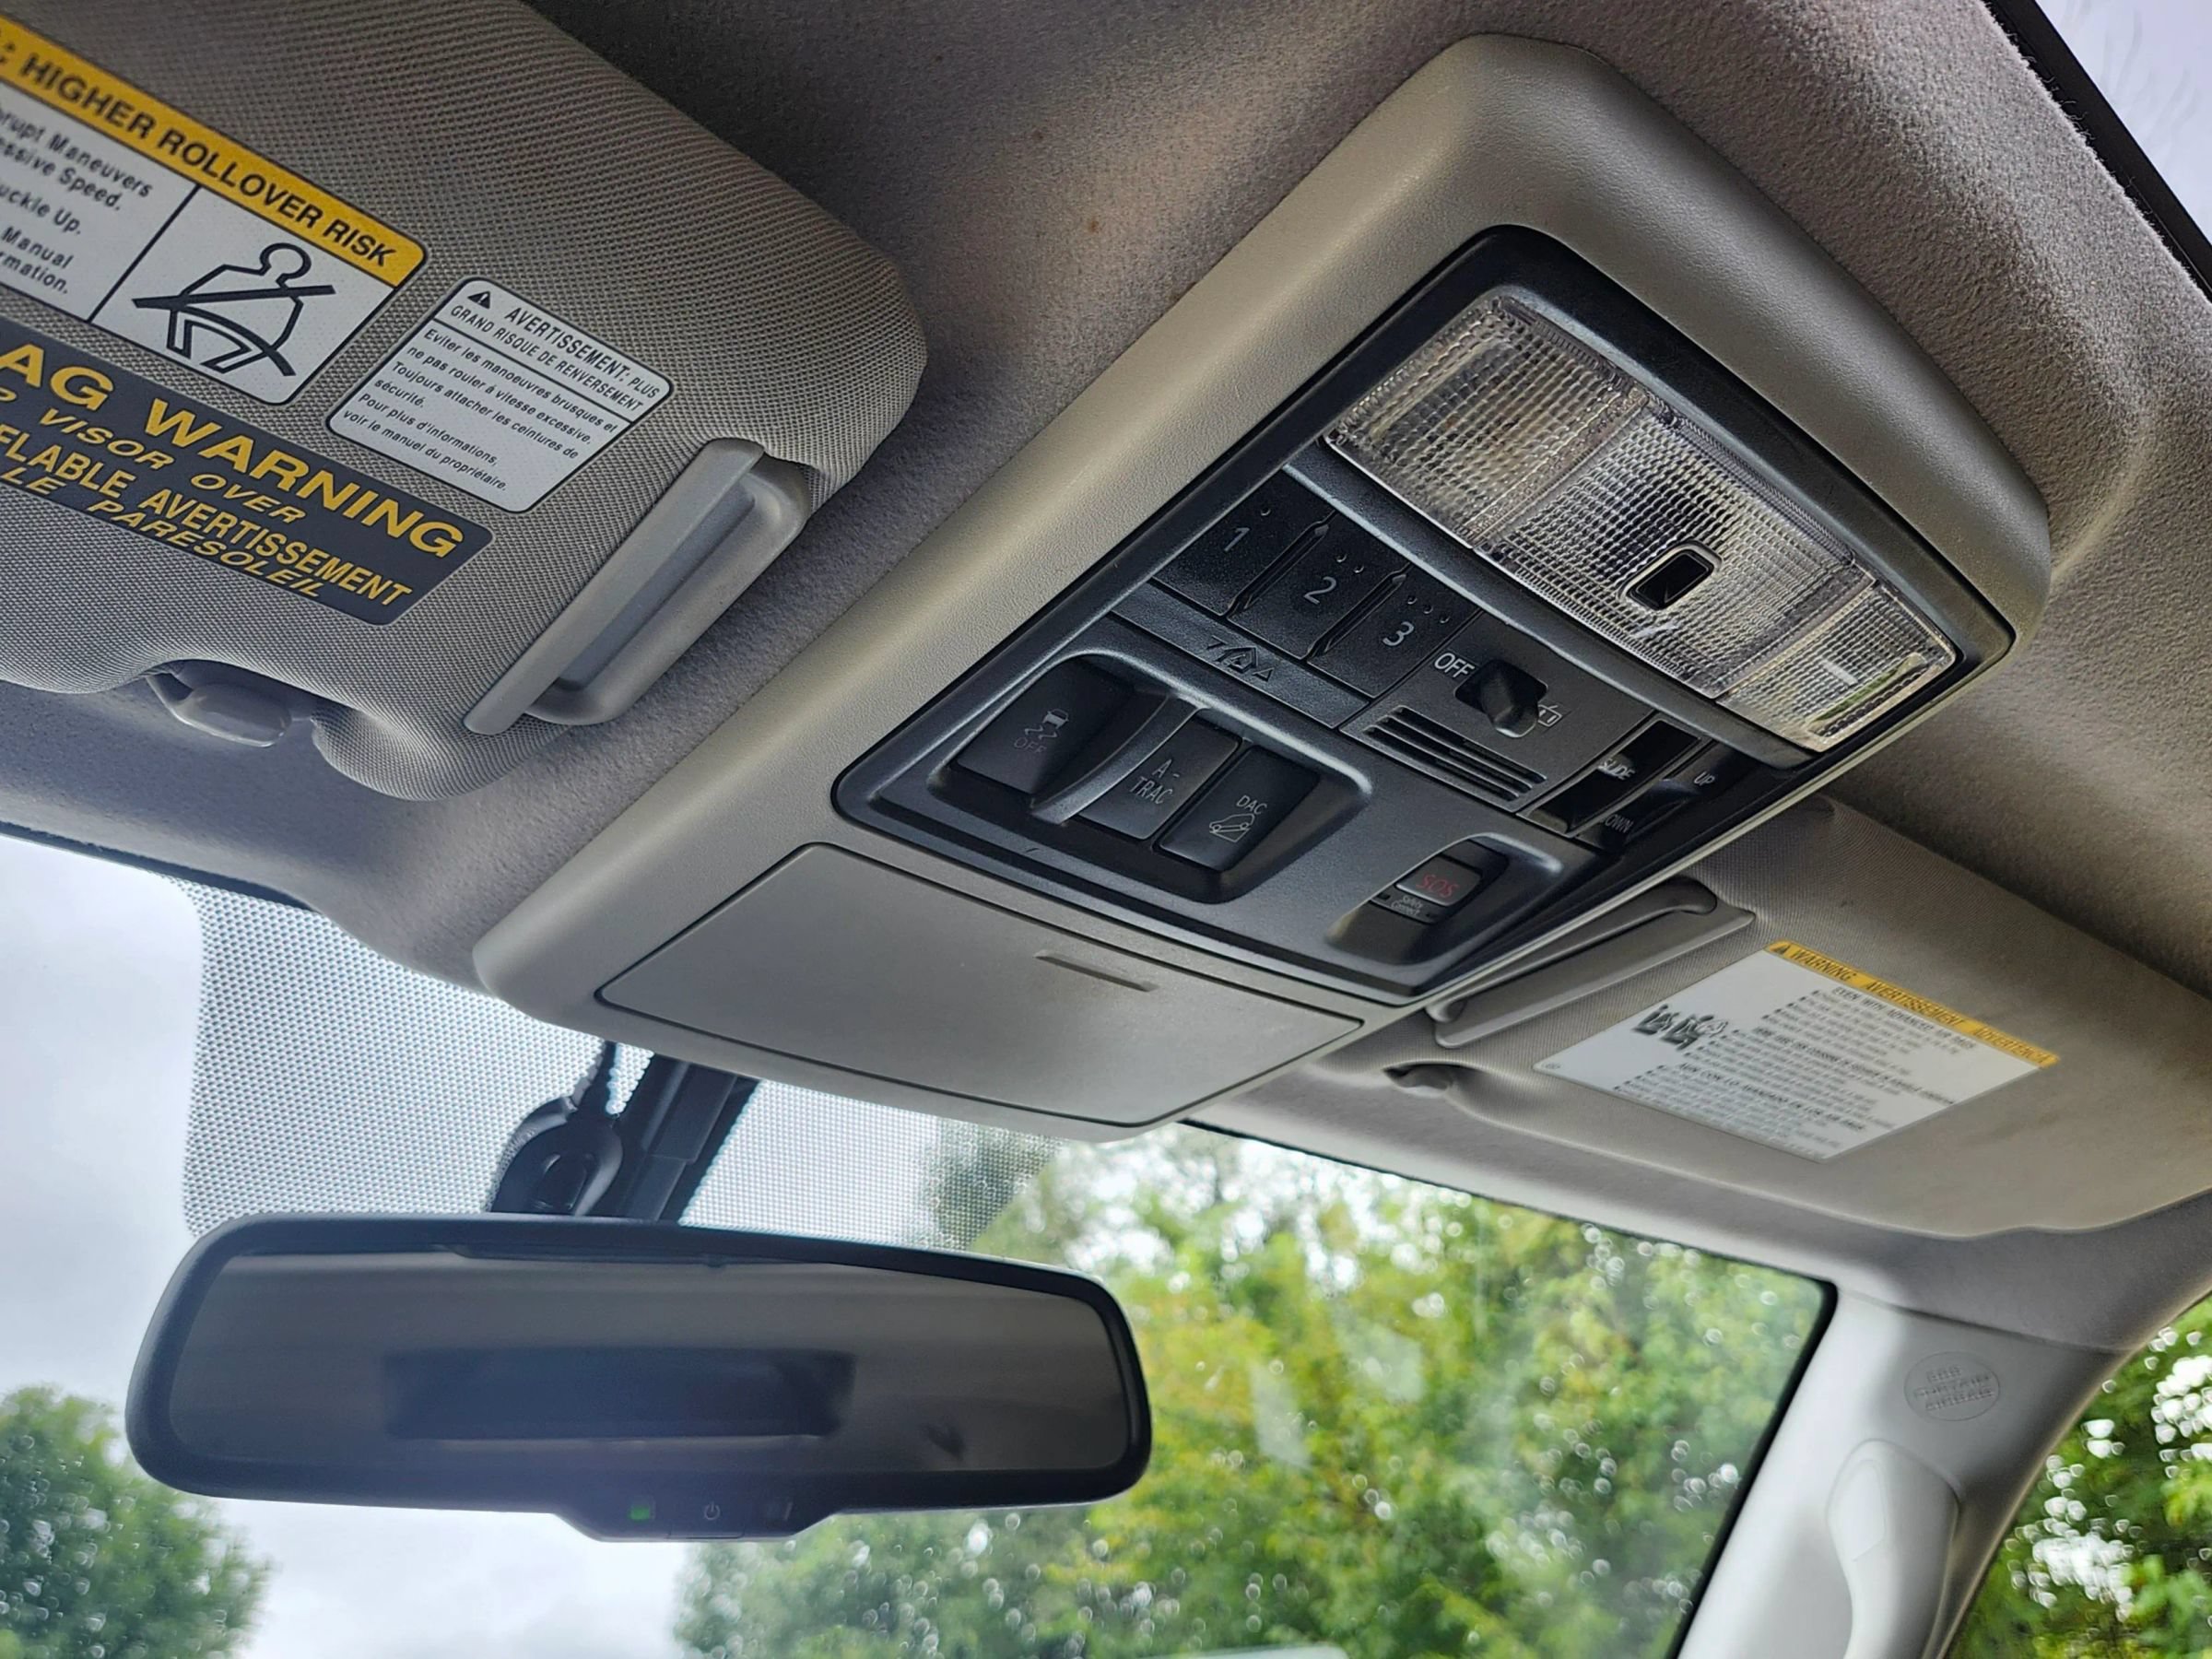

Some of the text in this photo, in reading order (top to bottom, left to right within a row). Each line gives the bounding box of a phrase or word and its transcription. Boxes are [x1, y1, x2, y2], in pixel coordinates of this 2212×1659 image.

[19, 53, 395, 267] HIGHER ROLLOVER RISK
[48, 133, 153, 197] Maneuvers
[59, 167, 123, 211] Speed.
[53, 207, 81, 234] Up.
[1, 226, 74, 270] Manual
[451, 305, 643, 411] GRAND RISQUE DE RENVERSEMENT
[504, 308, 660, 398] AVERTISSEMENT: PLUS
[374, 380, 425, 407] sécurité.
[407, 347, 424, 359] ne
[422, 356, 448, 371] pas
[449, 368, 486, 388] rouler
[496, 391, 535, 414] vitesse
[536, 412, 590, 444] excessive.
[424, 329, 618, 432] Eviter les manoeuvres brusques et
[359, 394, 497, 465] Pour plus d'informations,
[393, 361, 578, 458] Toujours attacher les ceintures de
[0, 343, 464, 559] AG WARNING
[39, 407, 307, 524] VISOR OVER
[344, 411, 505, 490] voir le manuel du propriétaire.
[0, 466, 324, 598] LE PARESOLEIL
[137, 488, 413, 607] AVERTISSEMENT
[1224, 526, 1250, 552] 1
[1303, 576, 1336, 606] 2
[1382, 621, 1415, 647] 3
[1434, 653, 1475, 680] OFF
[1014, 737, 1047, 755] OFF
[1129, 776, 1173, 805] TRAC
[1598, 758, 1636, 781] SLIDE
[1693, 771, 1716, 787] UP
[1236, 794, 1268, 816] DAC
[1604, 814, 1635, 834] OWN
[1416, 874, 1461, 899] SOS
